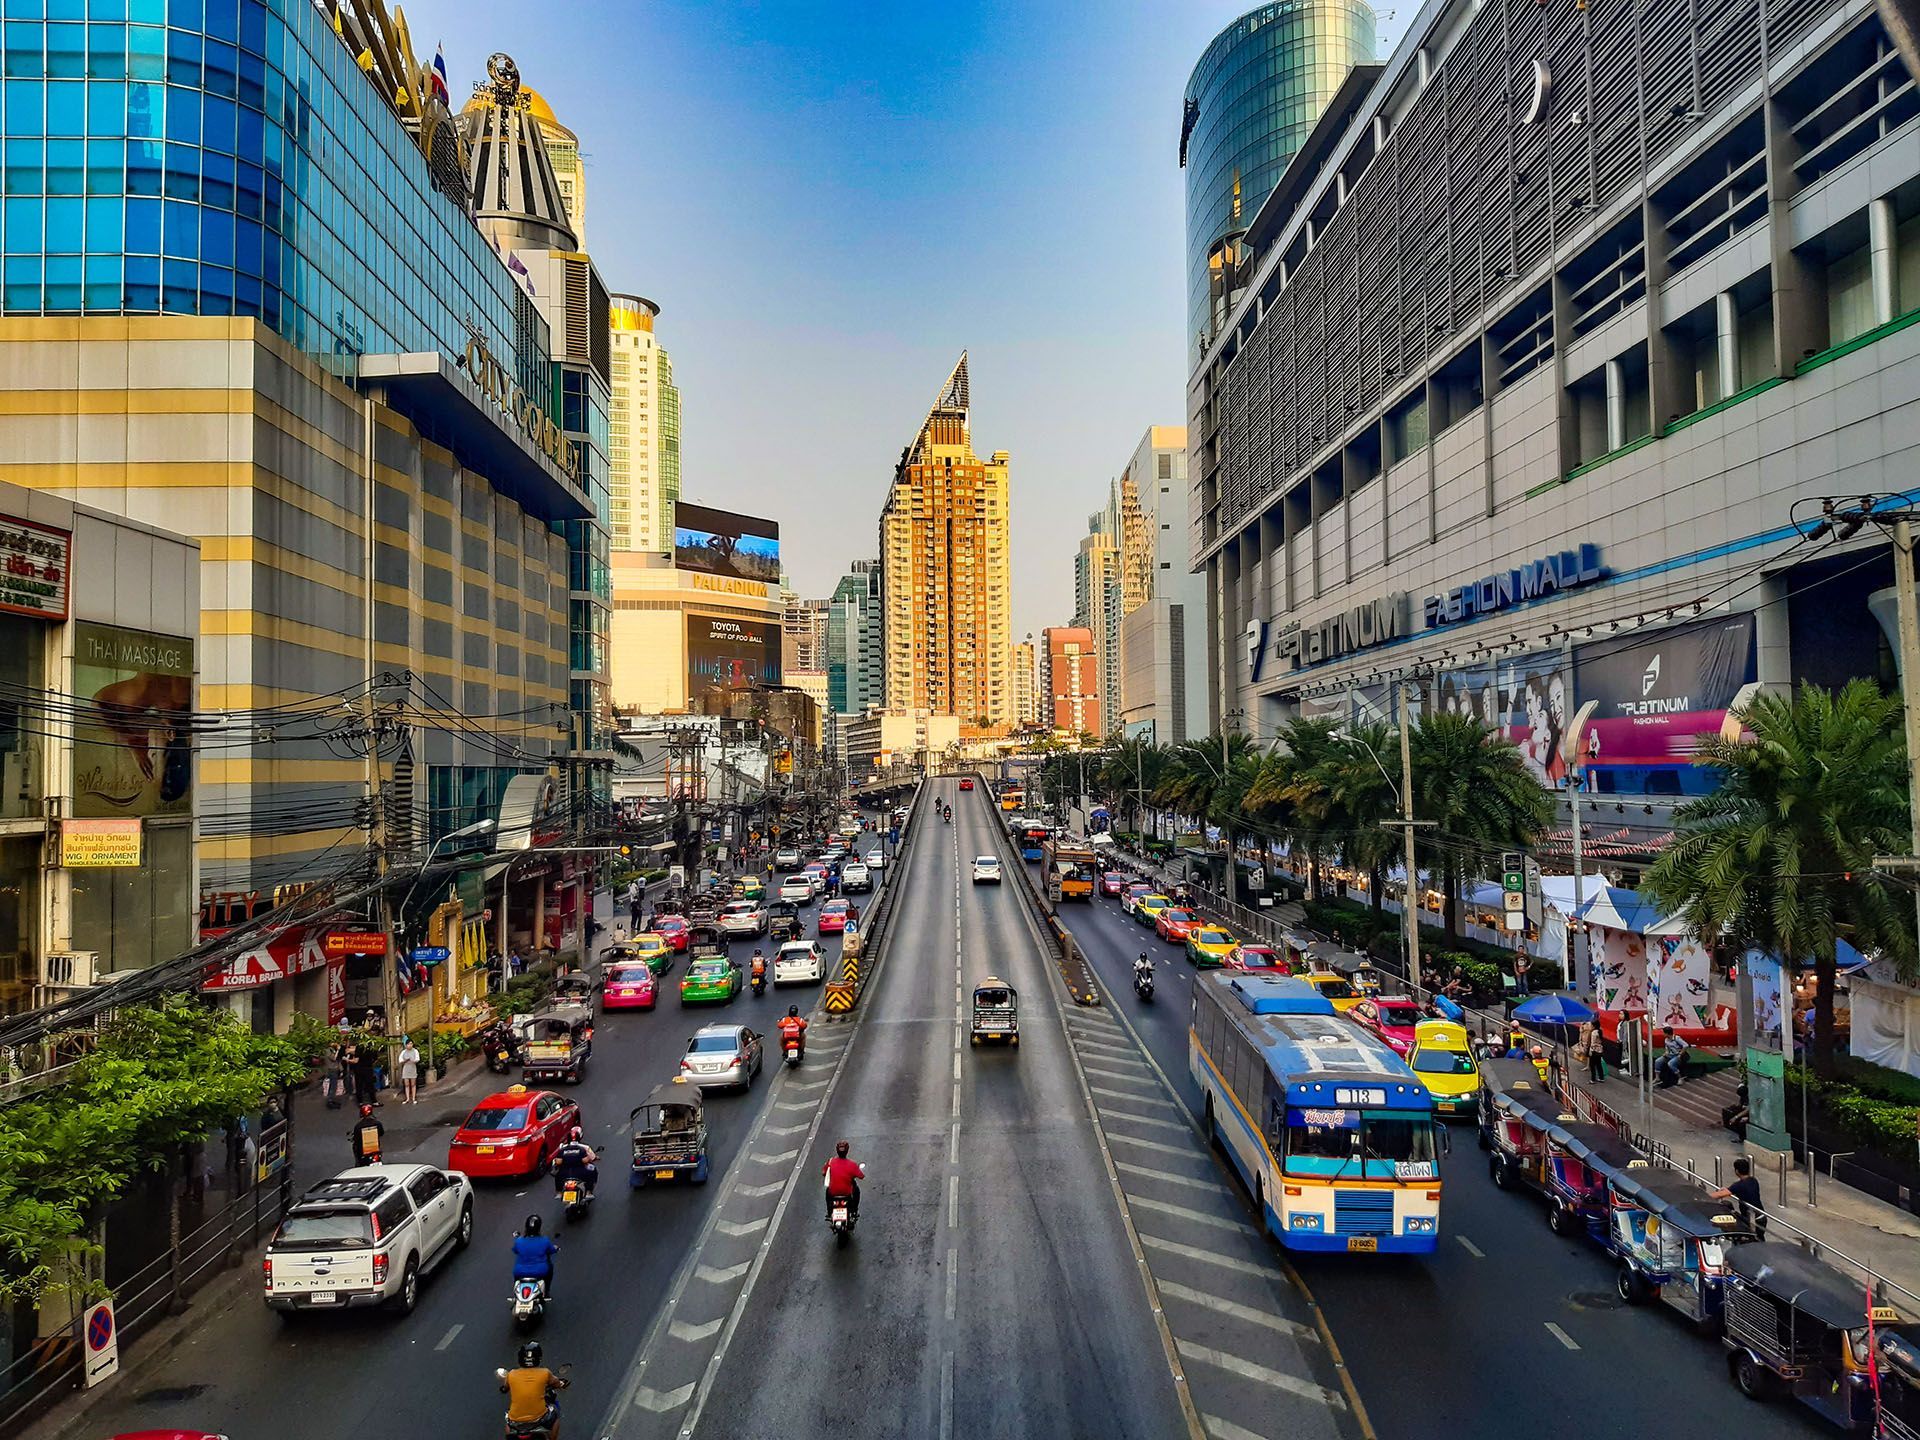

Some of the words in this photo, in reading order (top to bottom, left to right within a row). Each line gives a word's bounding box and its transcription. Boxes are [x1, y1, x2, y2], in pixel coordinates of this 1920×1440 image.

[466, 338, 511, 413] CITY
[693, 574, 769, 597] PALLADIUM
[1424, 569, 1515, 628] FASHION
[1520, 543, 1601, 600] MALL
[712, 621, 741, 633] TOYOTA
[709, 632, 727, 640] SPIRIT
[736, 633, 763, 643] FOOBALL
[87, 637, 117, 660] THAI
[121, 645, 181, 668] MASSAGE
[1633, 717, 1654, 725] FASHION
[1654, 716, 1670, 724] MALL
[91, 852, 138, 860] ORNAMENT
[437, 949, 445, 957] 21
[223, 974, 257, 985] KOREA
[260, 970, 284, 982] BRAND
[1349, 1089, 1370, 1104] 113
[277, 1278, 369, 1287] RANGER
[1874, 1310, 1893, 1318] TAXI
